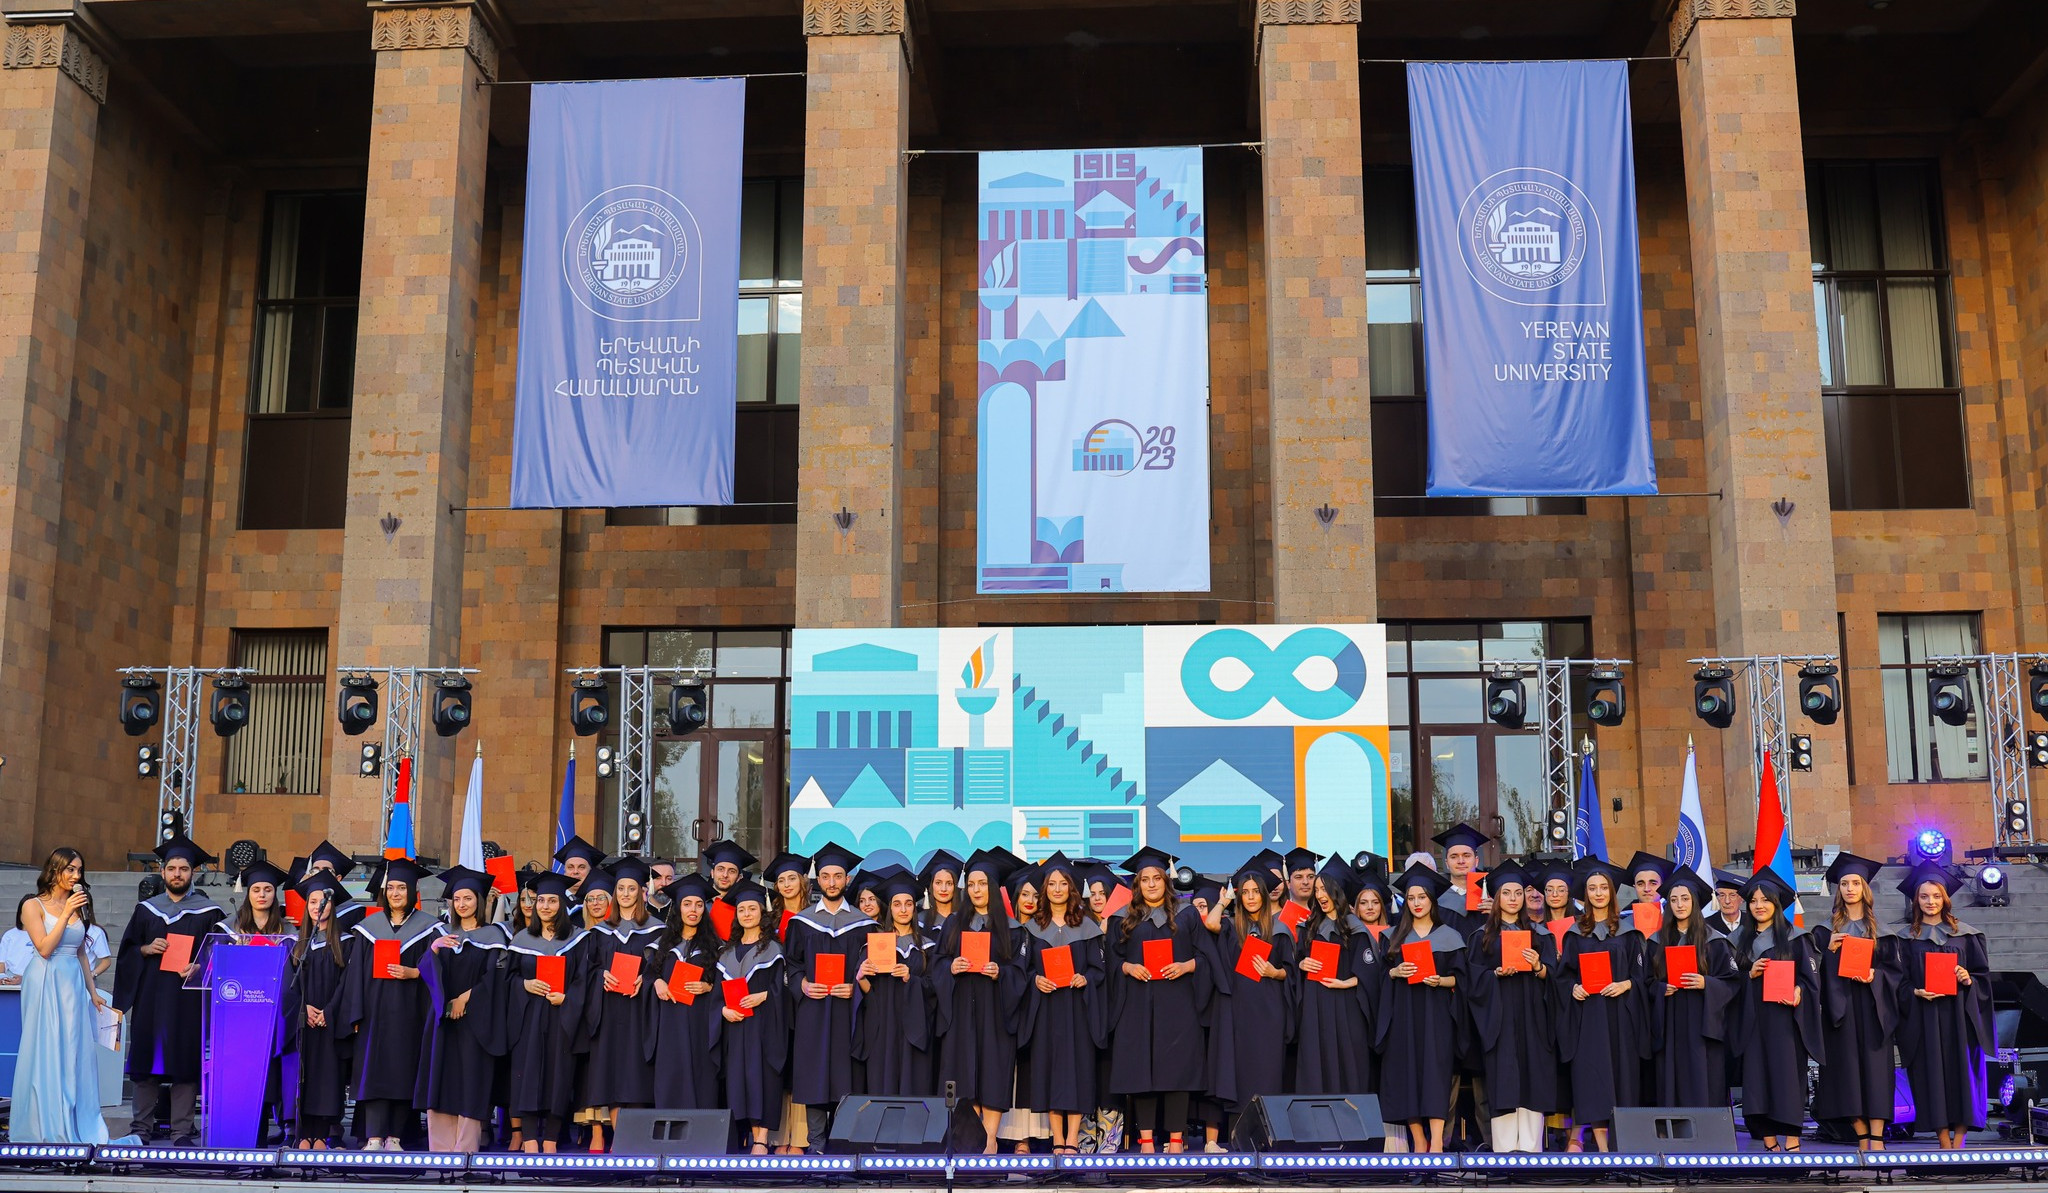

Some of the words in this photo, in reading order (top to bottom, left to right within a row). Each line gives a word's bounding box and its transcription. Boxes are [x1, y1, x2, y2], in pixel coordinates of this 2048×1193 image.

[1074, 154, 1135, 178] 1919
[1496, 184, 1542, 198] ՊԵՏԱԿԱՆ
[604, 201, 648, 215] ՊԵՏԱԿԱՆ
[1479, 250, 1509, 283] YEREVAN
[1508, 277, 1535, 288] STATE
[1536, 255, 1578, 288] UNIVERSITY
[582, 268, 609, 299] YEREVAN
[608, 294, 633, 305] STATE
[634, 272, 678, 304] UNIVERSITY
[1520, 321, 1610, 339] YEREVAN
[600, 336, 700, 355] ԵՐԵՎԱՆԻ
[1553, 342, 1612, 360] STATE
[596, 357, 700, 375] ՊԵՏԱԿԱՆ
[1494, 363, 1613, 381] UNIVERSITY
[554, 377, 699, 398] ՀԱՄԱԼՍԱՐԱՆ
[1143, 425, 1176, 454] 20
[1144, 446, 1176, 470] 23
